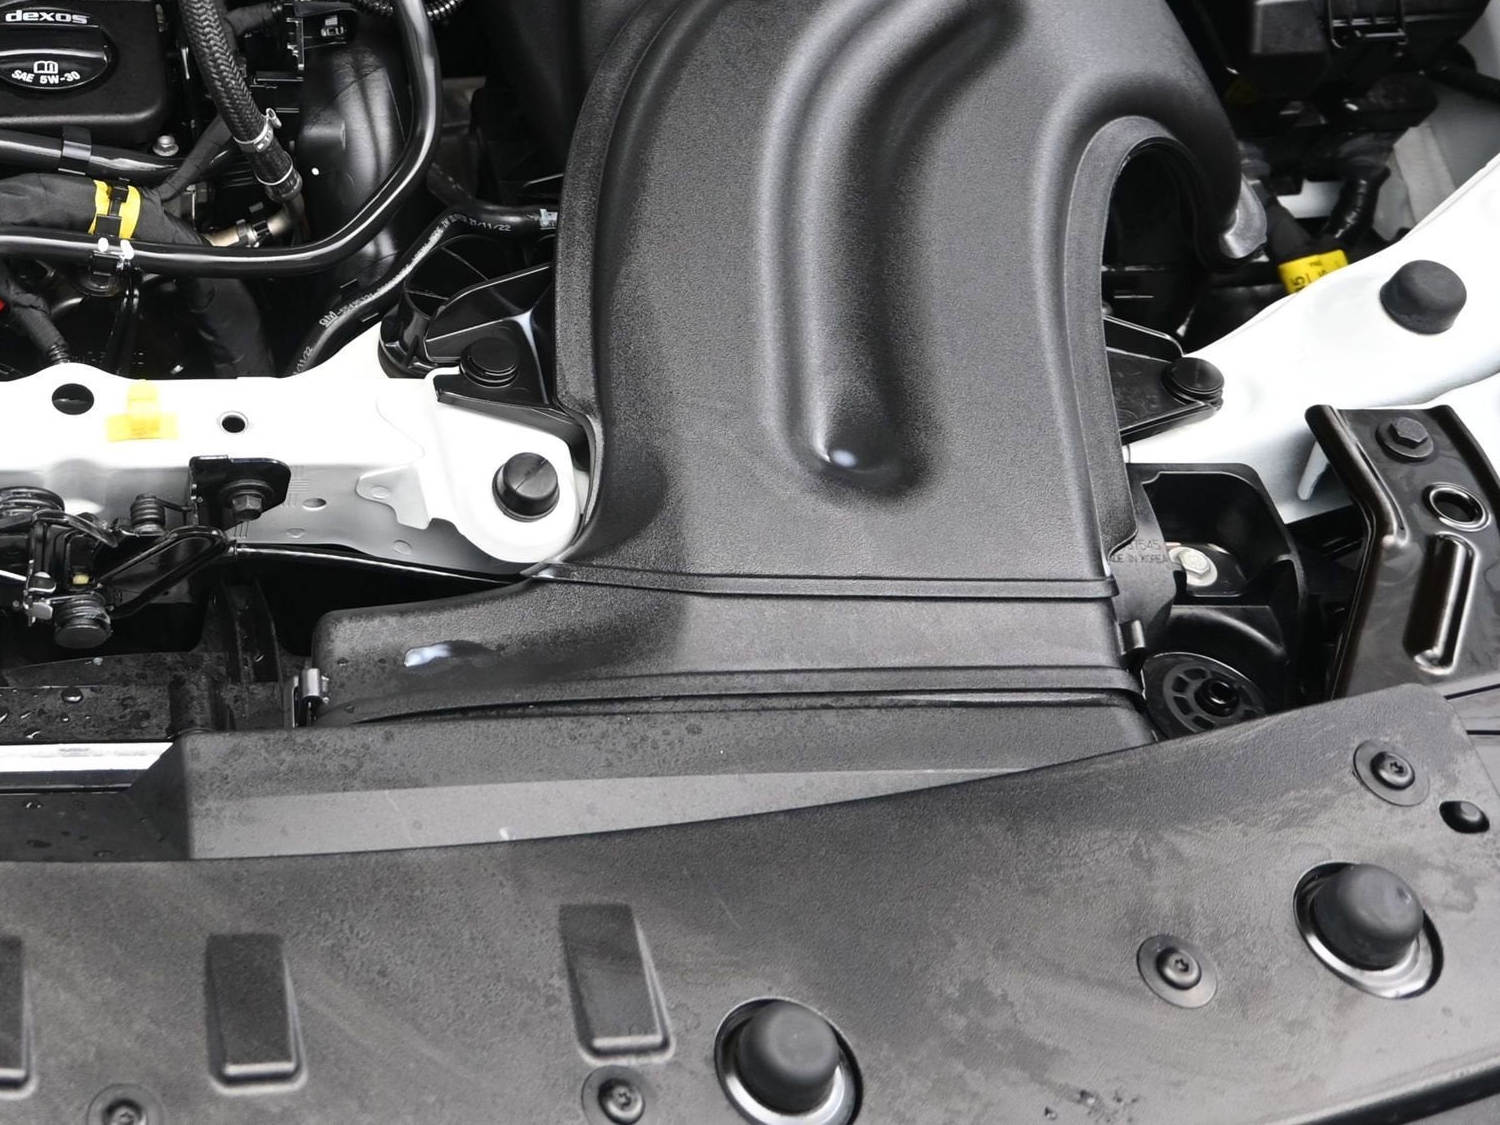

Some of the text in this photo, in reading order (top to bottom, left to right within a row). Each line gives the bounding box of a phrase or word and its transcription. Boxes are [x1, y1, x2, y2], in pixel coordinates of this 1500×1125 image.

[5, 9, 90, 24] dexos
[11, 69, 81, 84] SAE 5W-30
